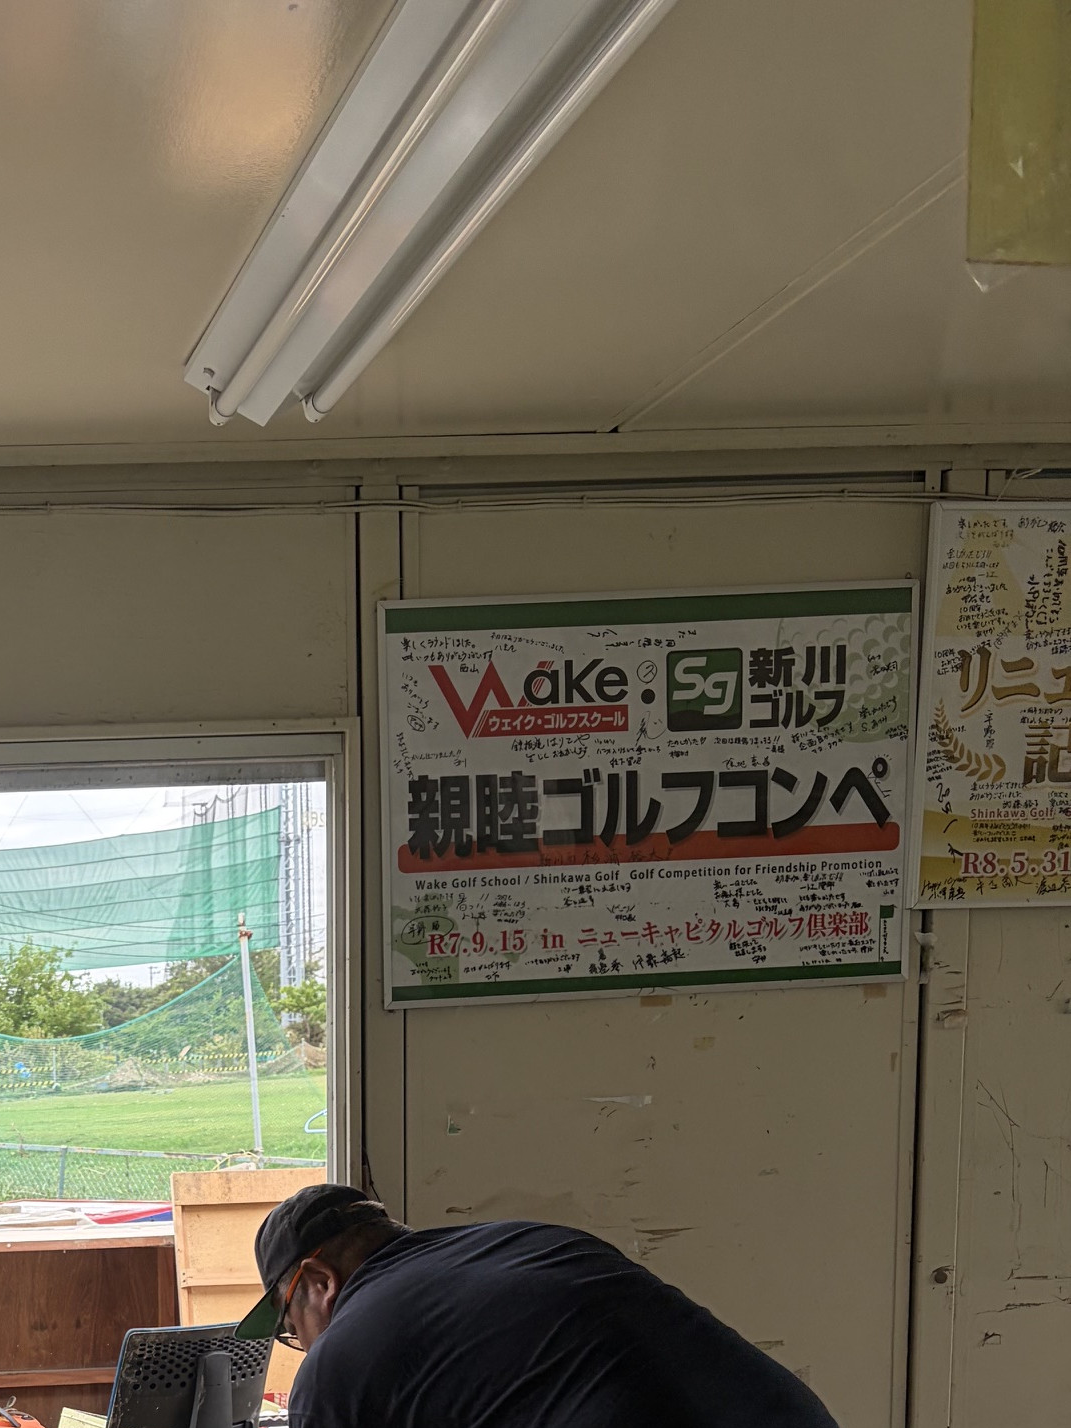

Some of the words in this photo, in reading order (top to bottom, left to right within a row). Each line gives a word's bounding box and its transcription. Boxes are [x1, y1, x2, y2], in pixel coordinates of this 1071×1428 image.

[748, 644, 847, 689] 新川
[488, 710, 626, 733] ウェイク・ゴルフスクール
[749, 689, 846, 730] ゴルフ
[406, 757, 892, 861] 親睦ゴルフコンペ
[970, 807, 1026, 819] Shinkawa
[1030, 806, 1054, 818] Golf
[415, 879, 447, 891] Wake
[452, 876, 478, 889] Golf
[481, 874, 521, 888] School
[534, 871, 591, 886] Shinkawa
[595, 870, 620, 882] Golf
[630, 869, 655, 881] Golf
[658, 864, 731, 881] Competition
[735, 864, 751, 877] for
[755, 861, 817, 875] Friendship
[821, 859, 882, 872] Promotion
[428, 929, 526, 957] R7.9.15
[541, 928, 566, 950] in
[577, 911, 870, 945] ニューキャピタルゴルフ倶楽部
